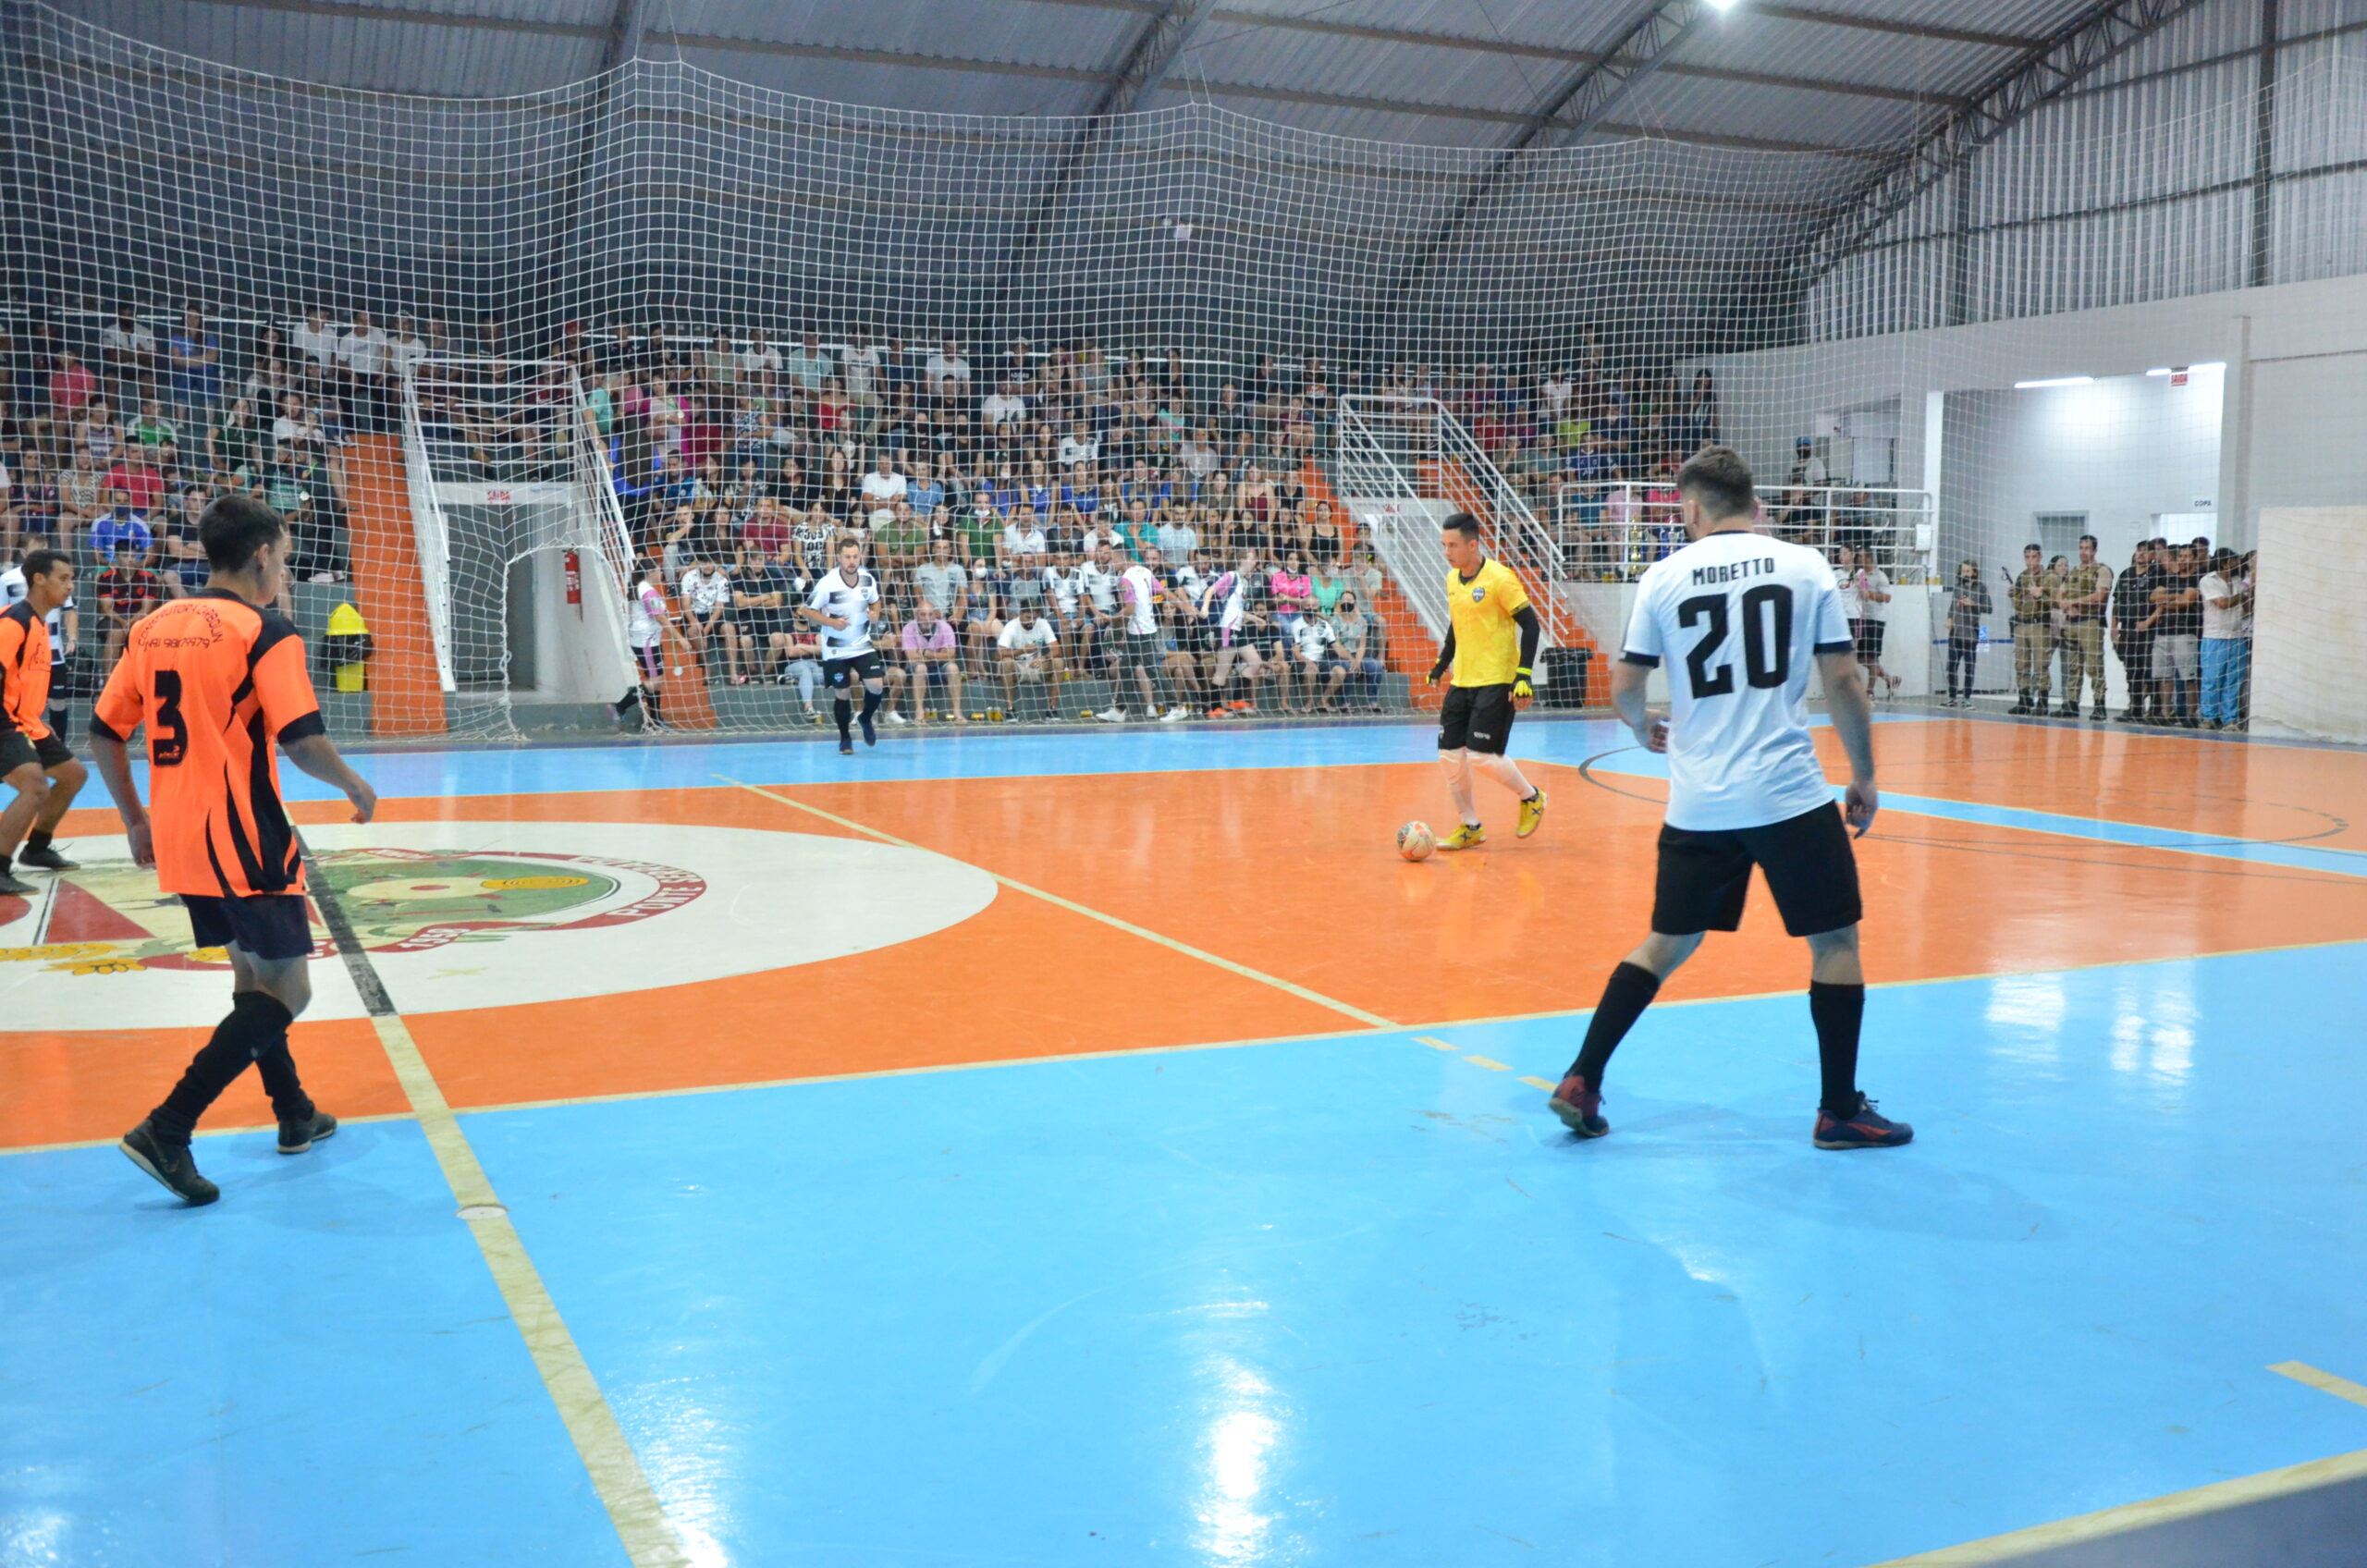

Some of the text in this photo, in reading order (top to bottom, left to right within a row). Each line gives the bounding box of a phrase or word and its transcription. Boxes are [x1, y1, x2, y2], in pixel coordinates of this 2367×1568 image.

[1693, 557, 1774, 585] MORETTO
[1678, 583, 1794, 699] 20
[153, 670, 189, 766] 3
[606, 887, 703, 916] PONTE
